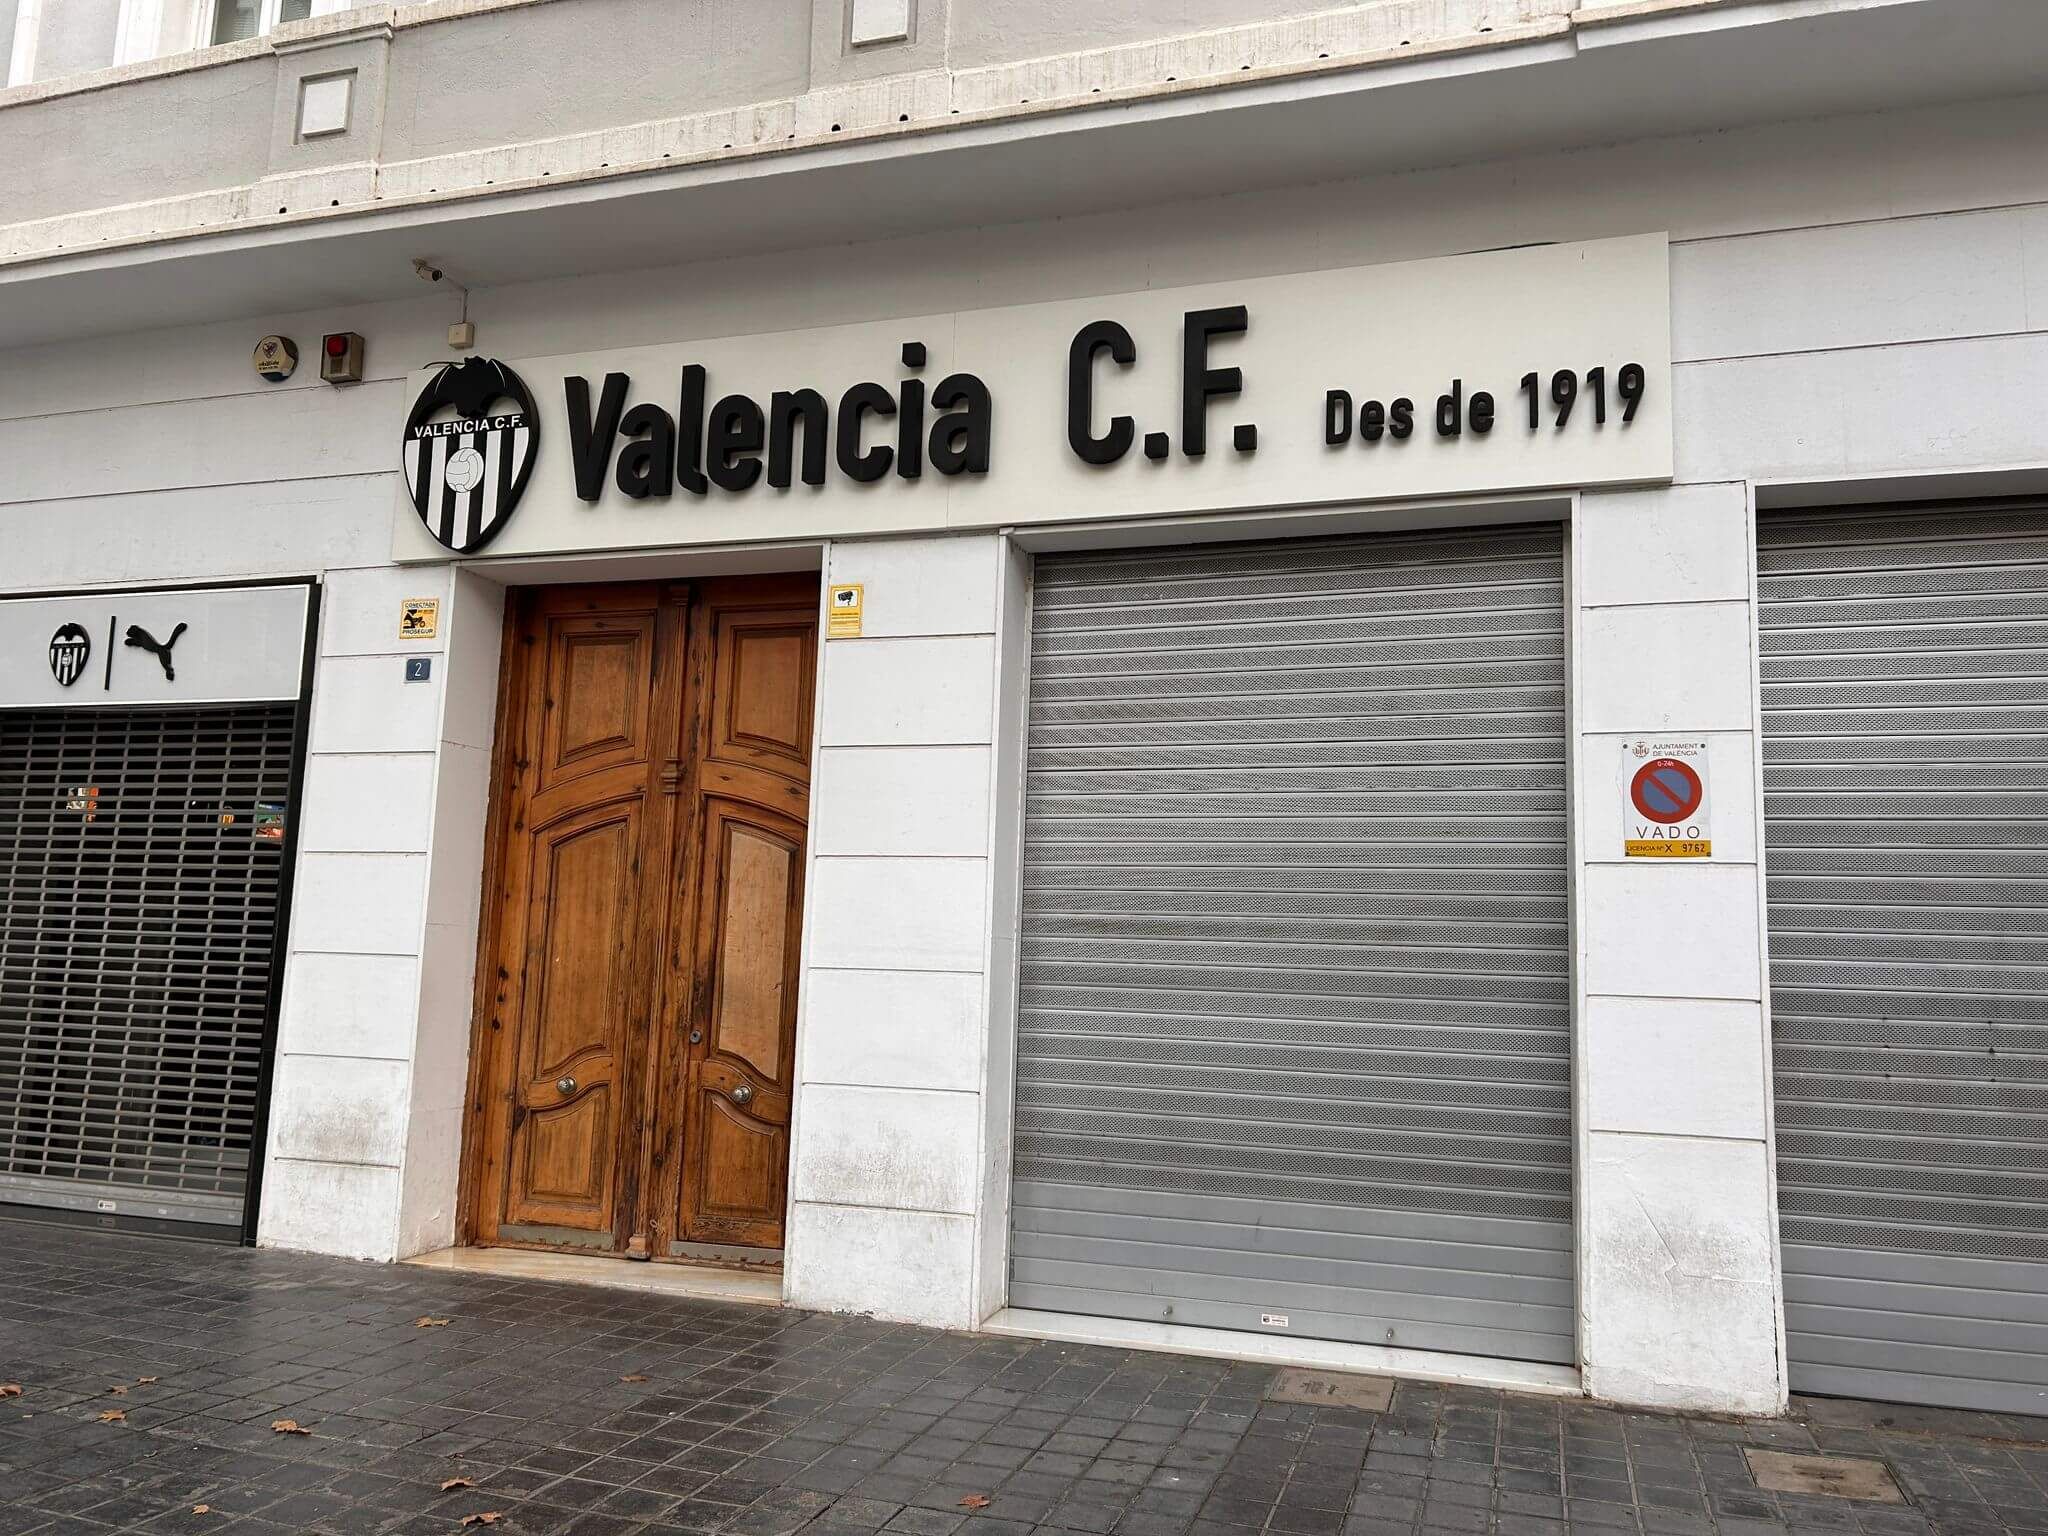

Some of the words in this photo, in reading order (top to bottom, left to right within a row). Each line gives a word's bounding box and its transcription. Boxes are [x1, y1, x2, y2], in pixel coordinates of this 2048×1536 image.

[564, 341, 992, 501] Valencia
[1068, 305, 1257, 464] C.F.
[1325, 389, 1414, 445] Des
[1436, 379, 1495, 437] de
[1520, 362, 1645, 429] 1919
[414, 419, 490, 439] VALENCIA
[494, 415, 523, 431] C.F.
[414, 662, 422, 677] 2
[1636, 825, 1700, 839] VADO
